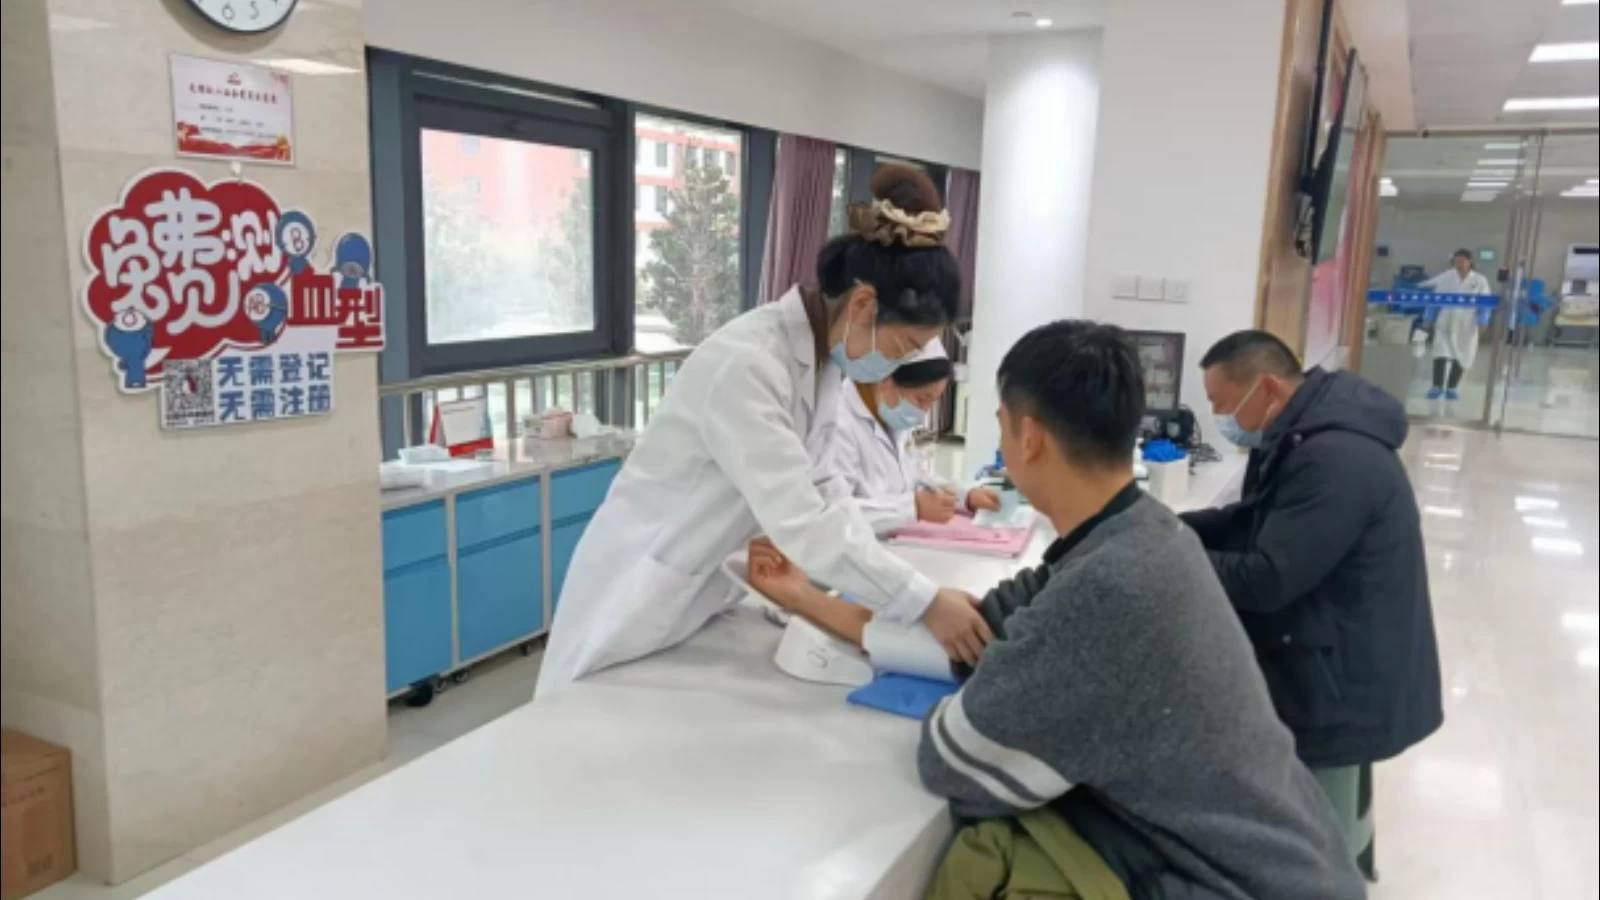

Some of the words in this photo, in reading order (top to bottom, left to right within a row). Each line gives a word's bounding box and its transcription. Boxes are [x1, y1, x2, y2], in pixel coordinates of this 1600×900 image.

[221, 2, 235, 20] 6
[286, 263, 384, 349] 血型
[217, 352, 331, 387] 无需登记
[218, 384, 331, 422] 无需注册
